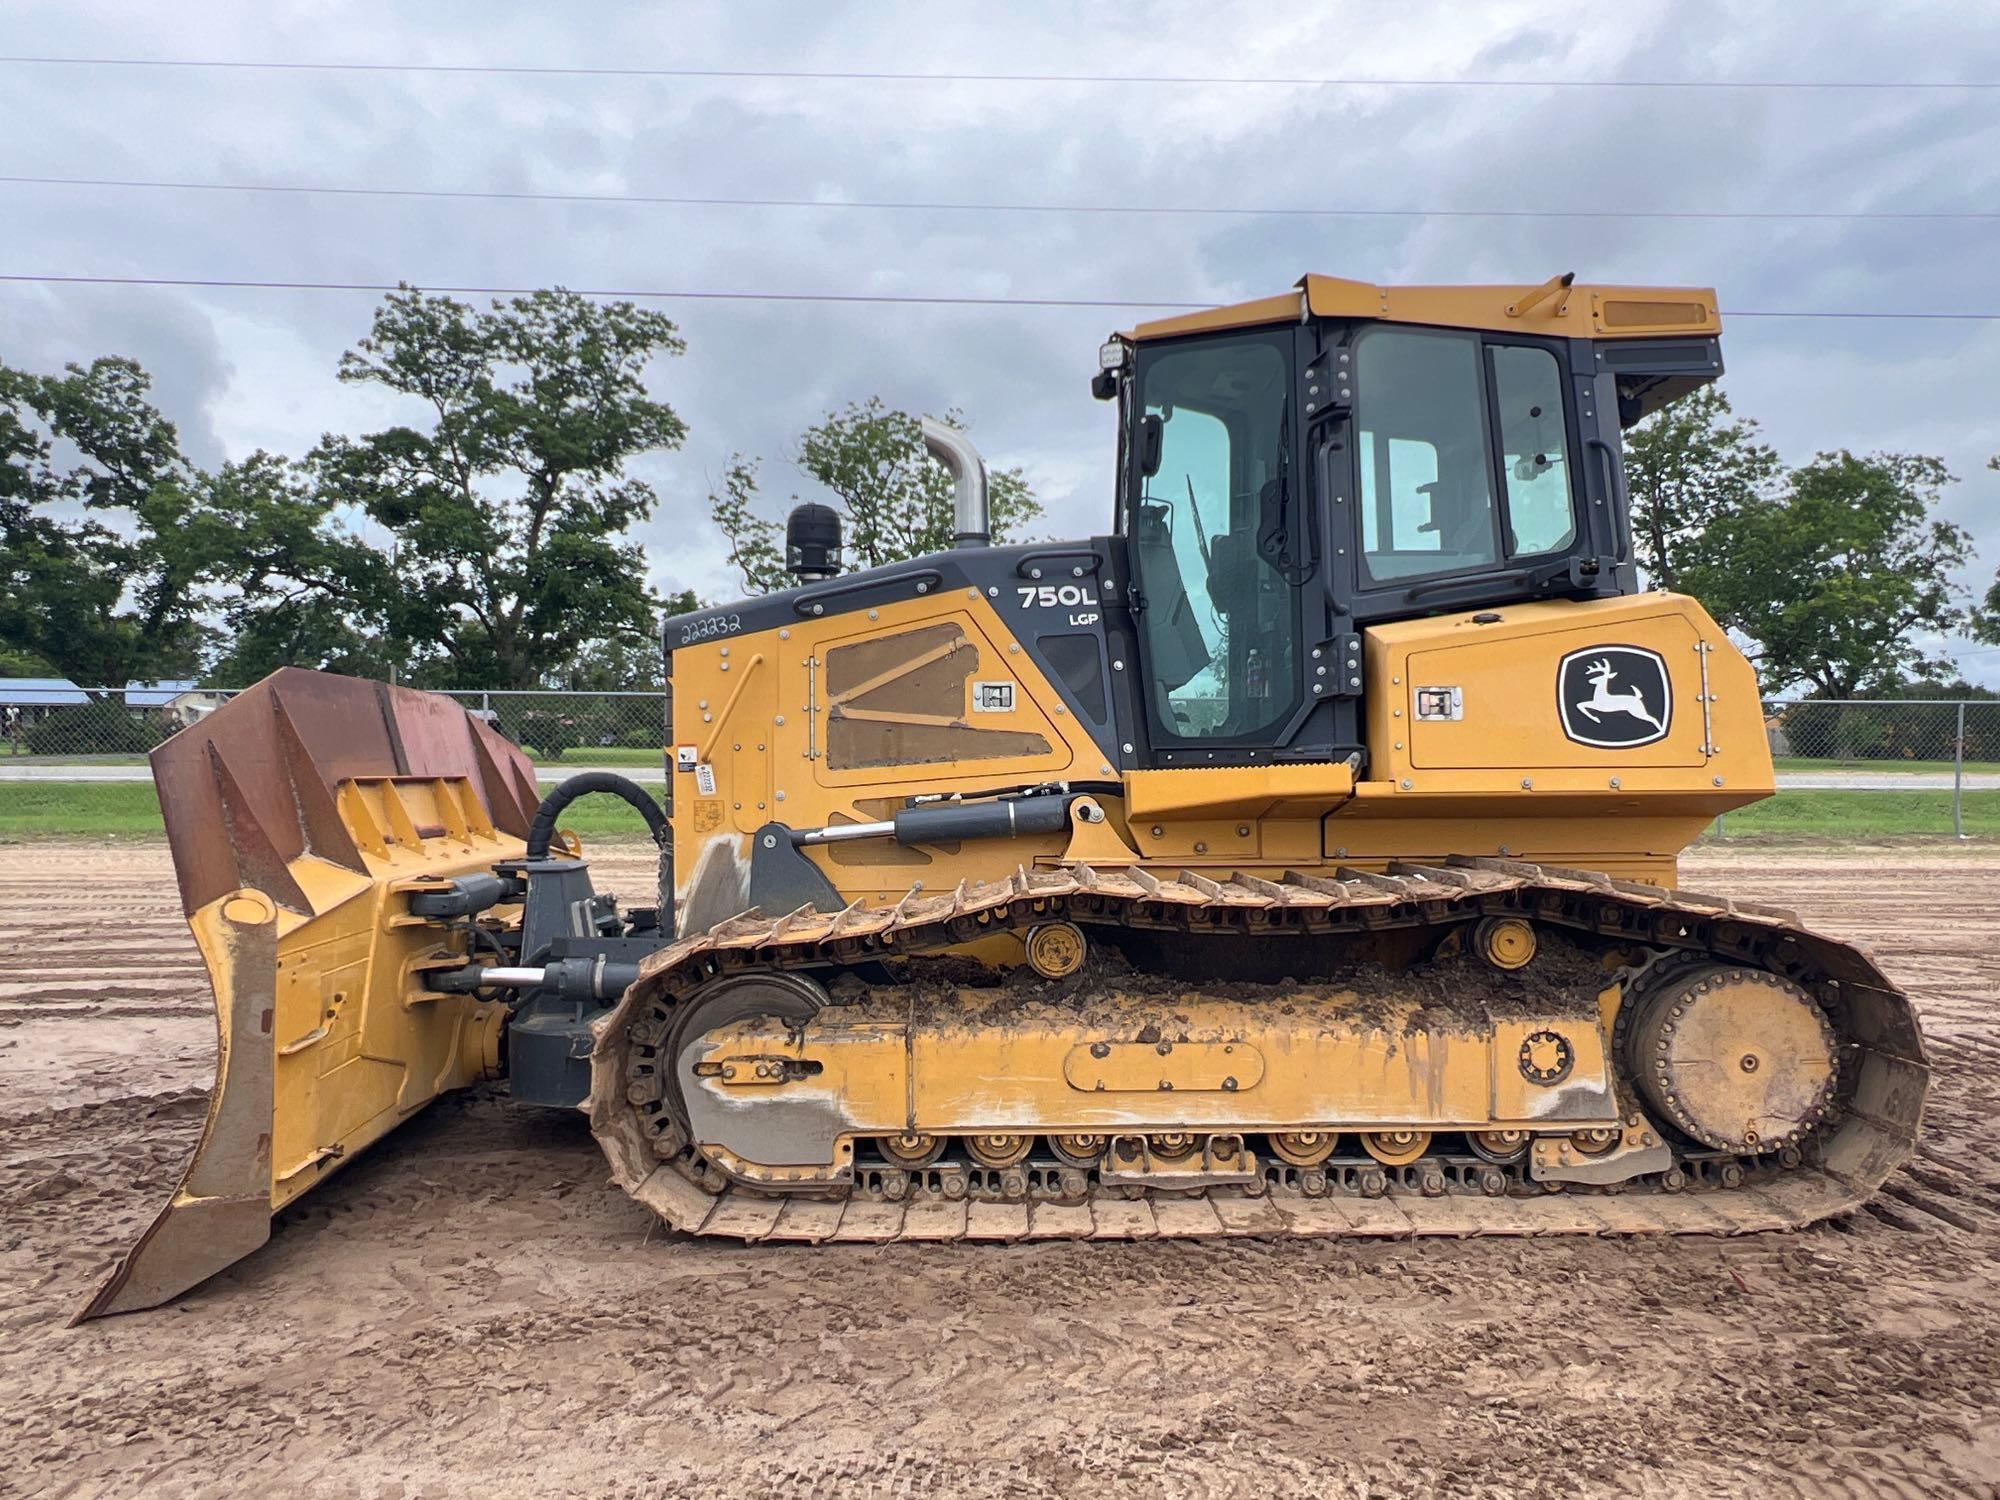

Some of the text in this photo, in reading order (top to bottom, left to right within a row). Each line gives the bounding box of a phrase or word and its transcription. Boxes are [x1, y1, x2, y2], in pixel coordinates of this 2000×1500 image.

[1017, 585, 1098, 609] 750L
[681, 614, 742, 644] 222232
[1069, 613, 1099, 626] LGP
